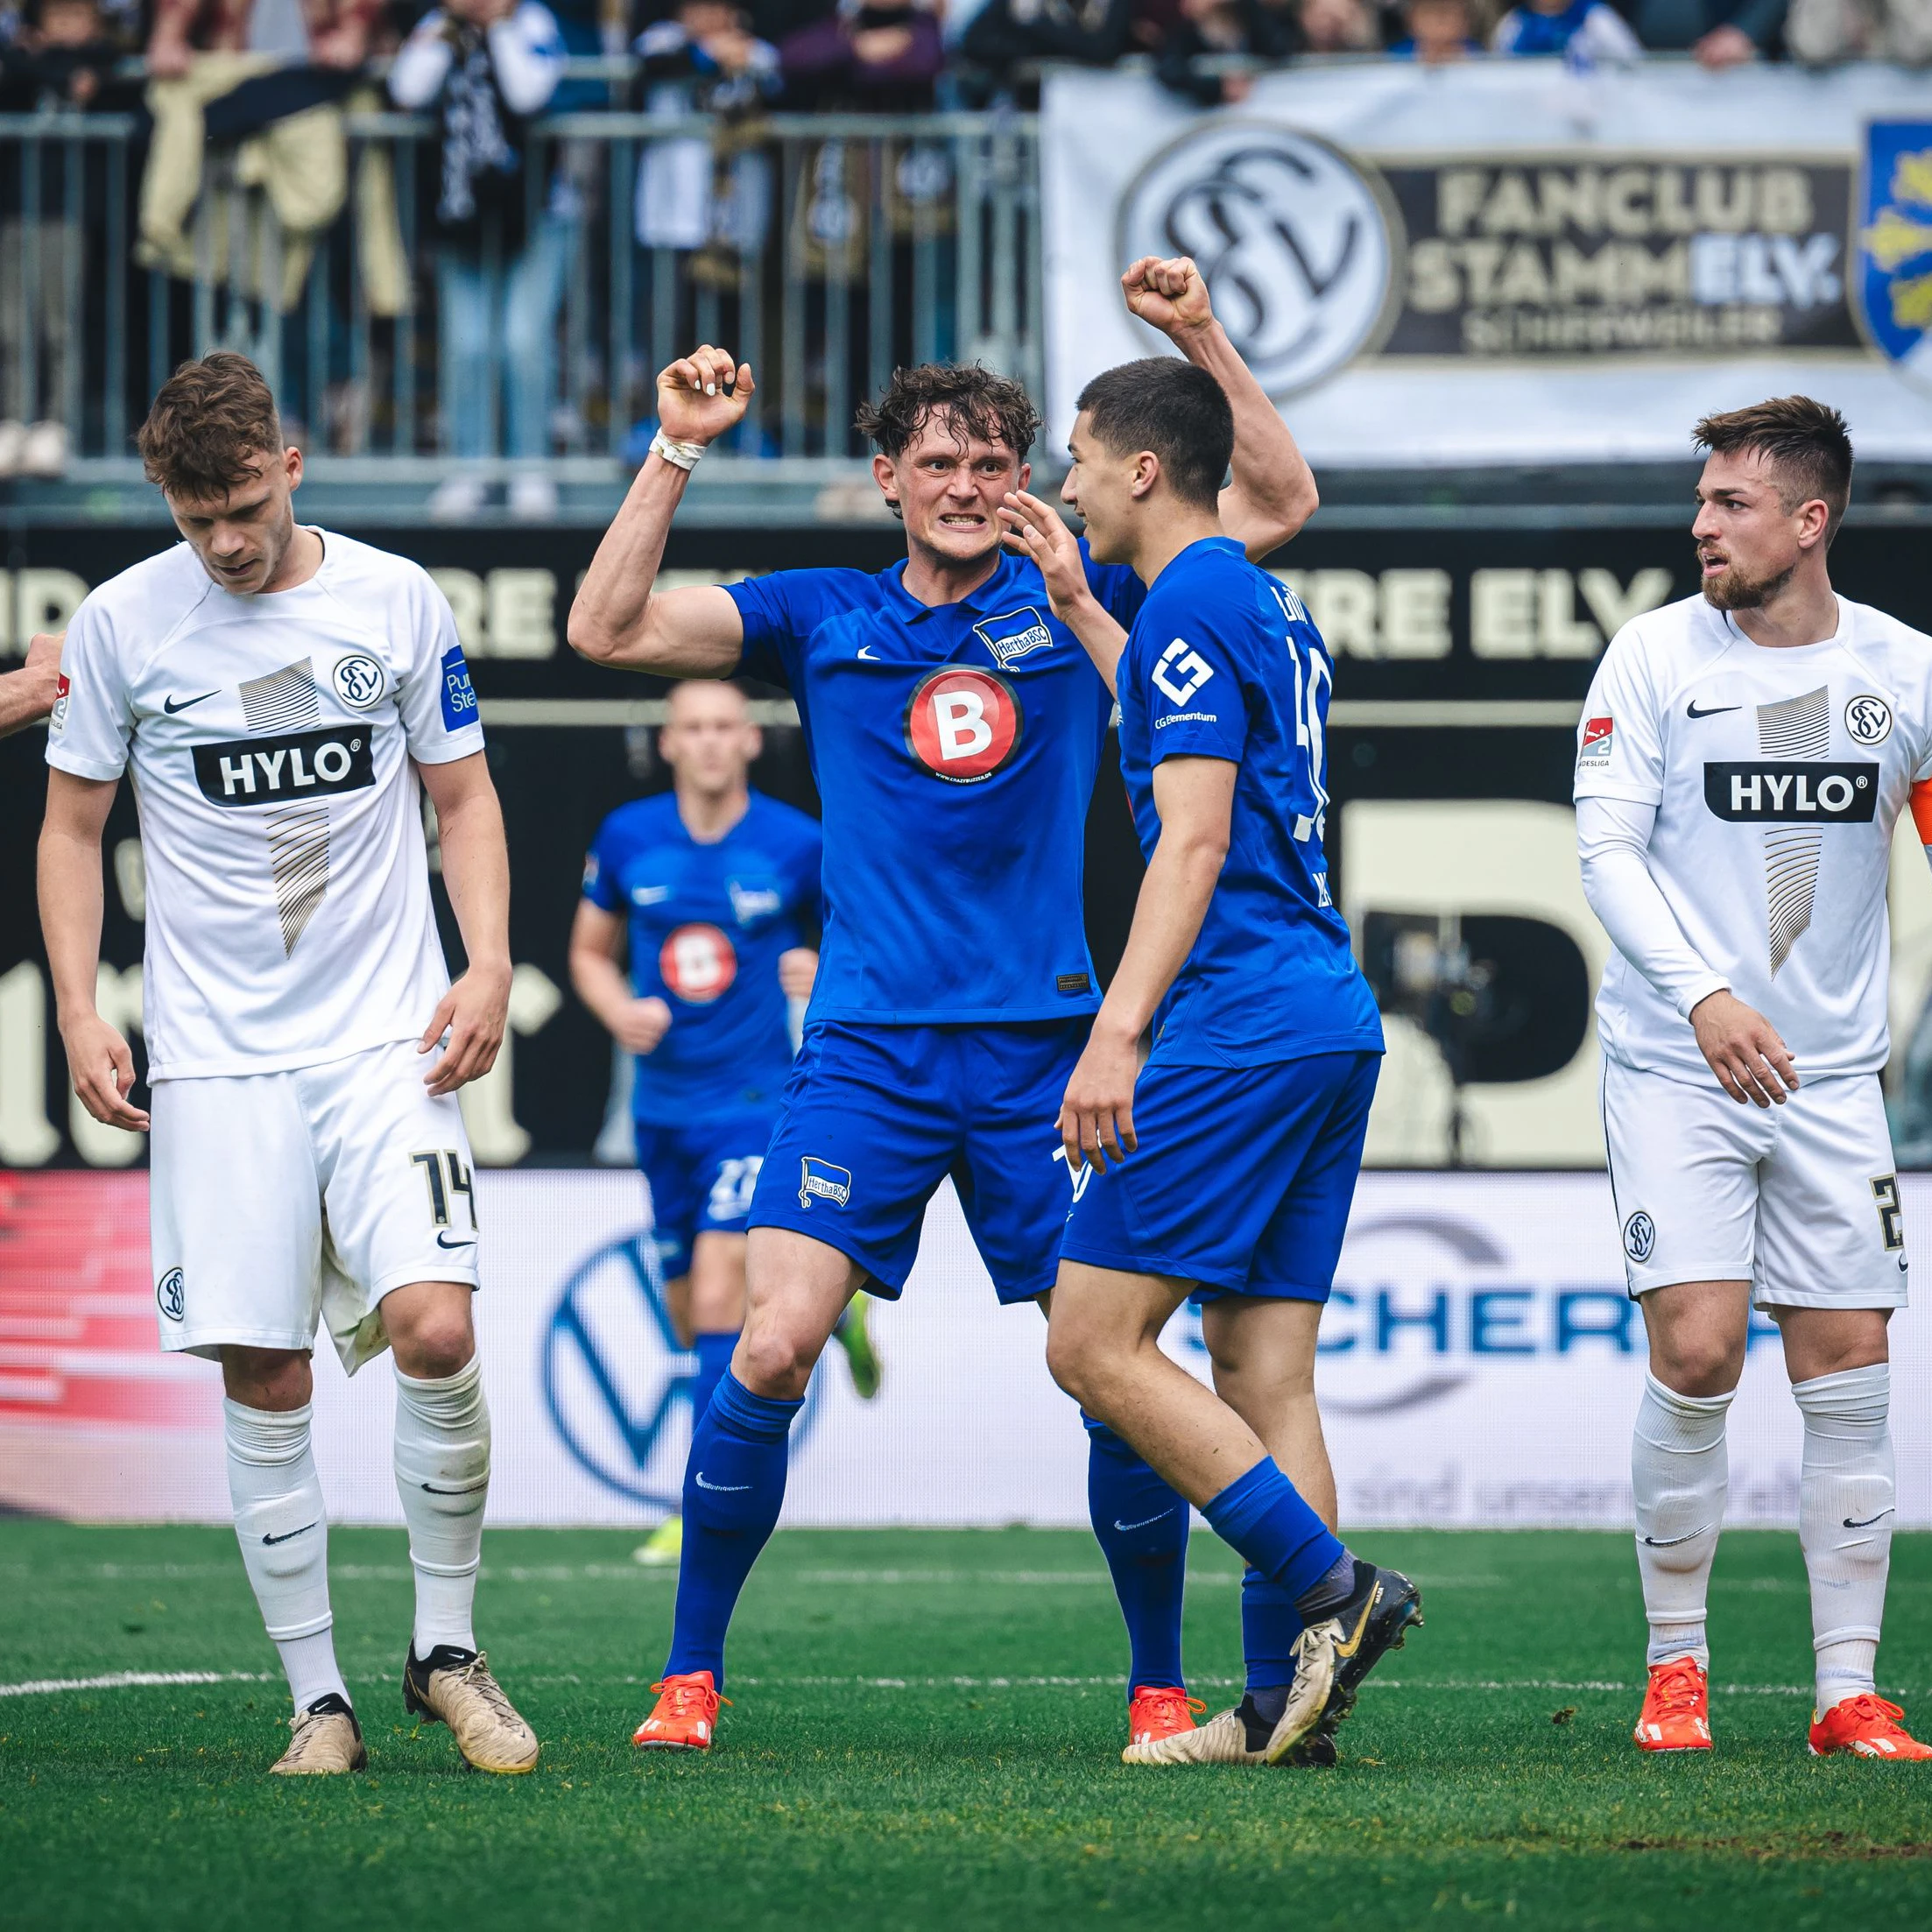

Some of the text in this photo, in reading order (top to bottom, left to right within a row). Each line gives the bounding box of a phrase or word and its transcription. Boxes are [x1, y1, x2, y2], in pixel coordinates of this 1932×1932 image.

[1435, 168, 1811, 235] FANCLUB
[933, 690, 992, 761] B
[1166, 712, 1217, 724] Eementum
[1597, 737, 1611, 754] 2
[408, 1149, 479, 1232] 14
